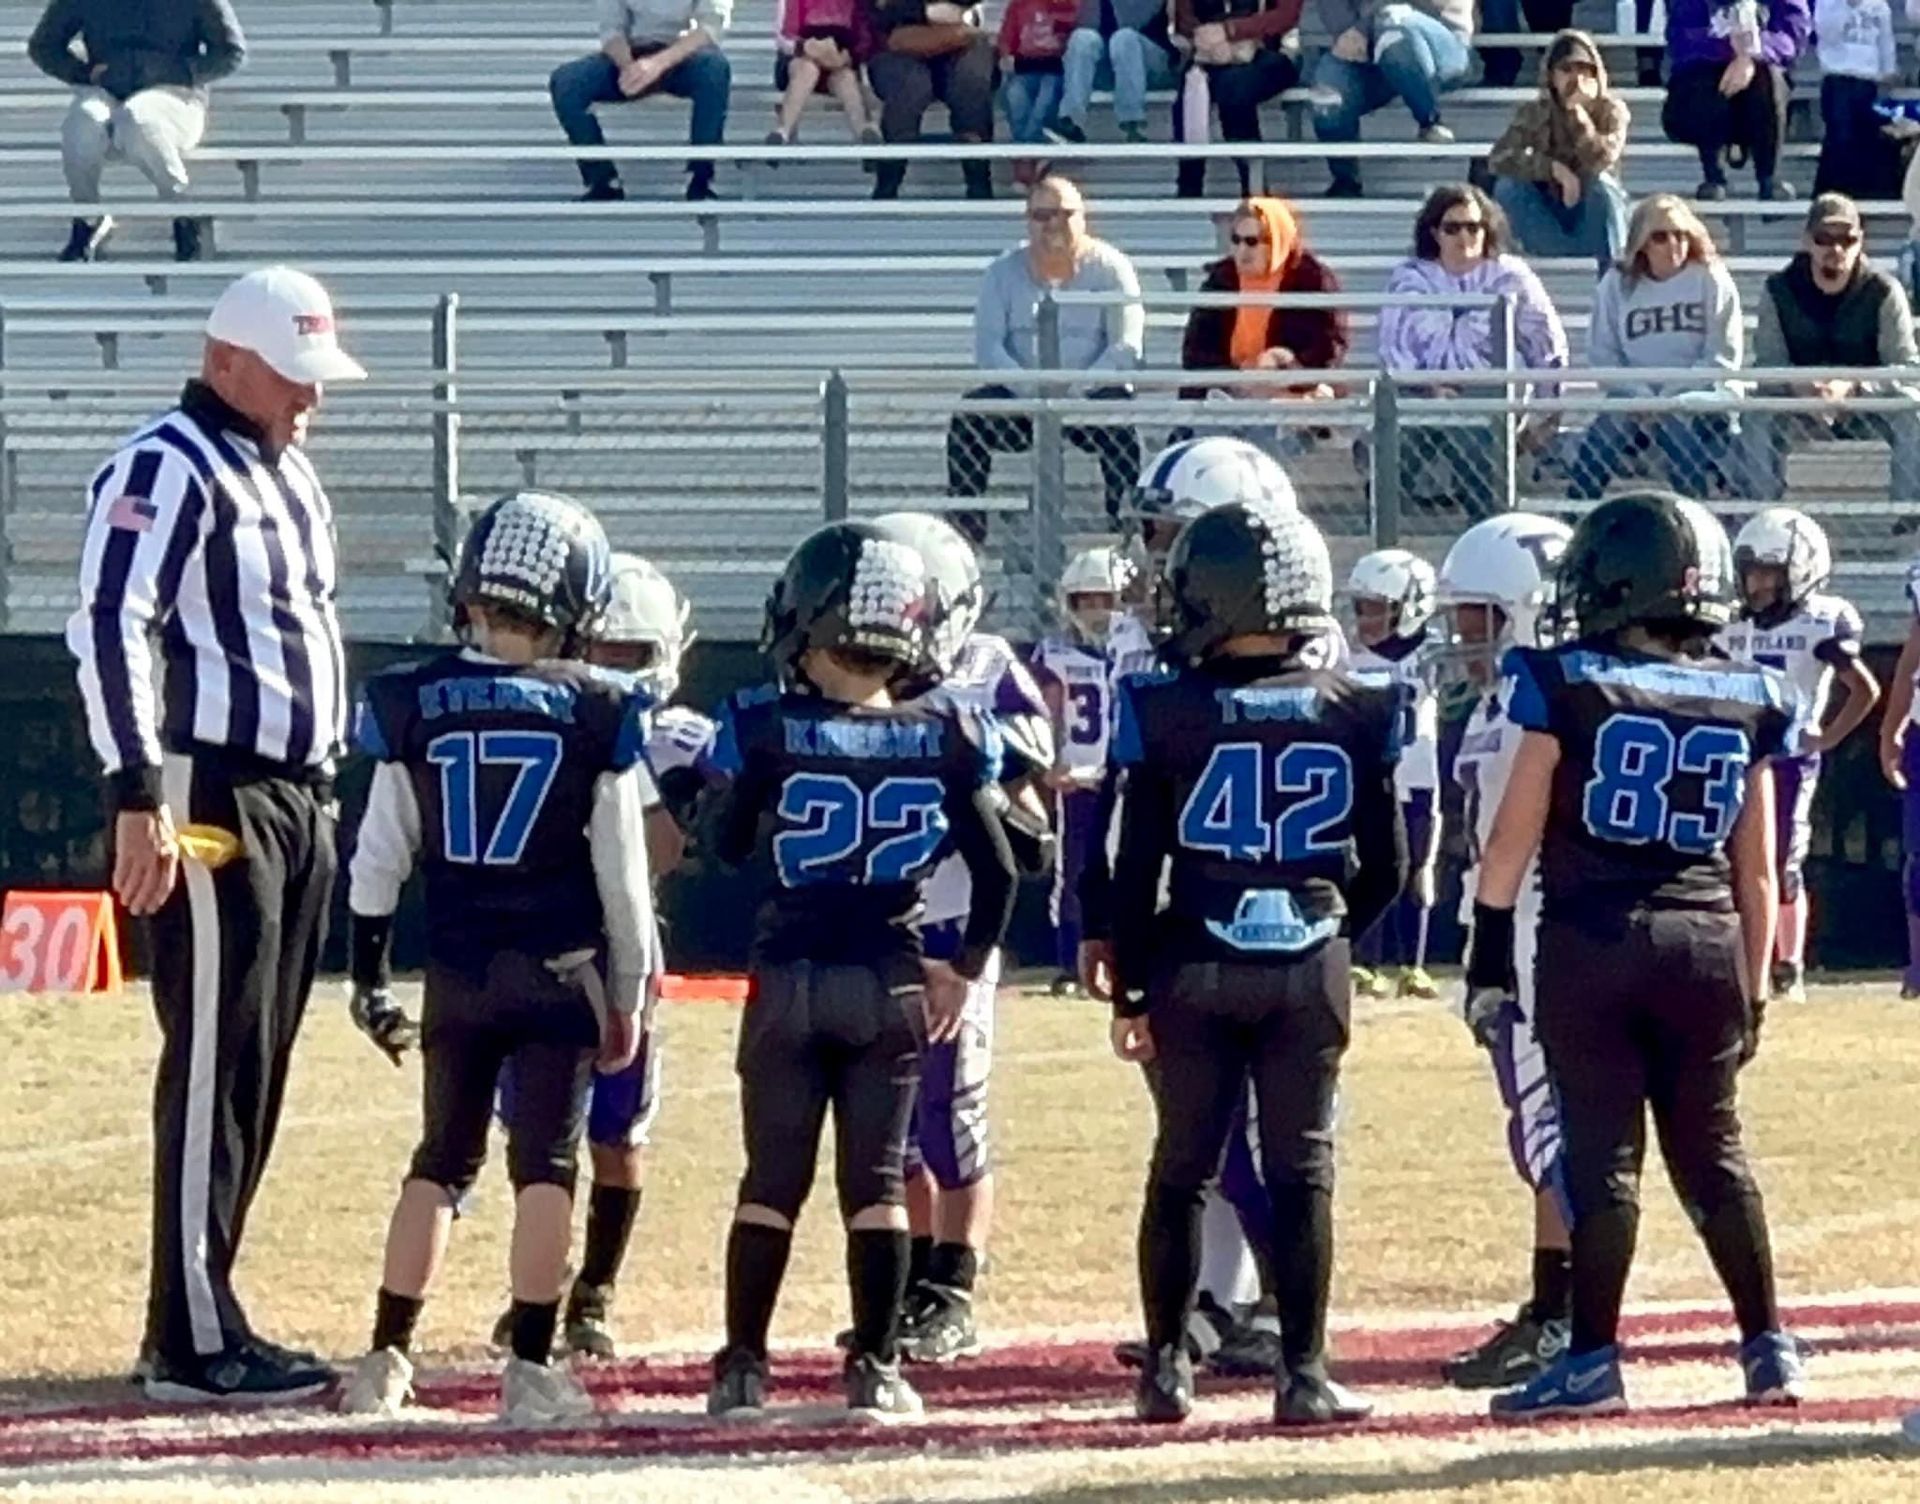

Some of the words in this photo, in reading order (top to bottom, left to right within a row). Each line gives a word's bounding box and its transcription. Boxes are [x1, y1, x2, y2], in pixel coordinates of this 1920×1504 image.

[1626, 302, 1706, 339] GHS
[1068, 683, 1102, 745] 3
[426, 731, 563, 865] 17
[773, 772, 949, 888] 22
[1178, 740, 1354, 863] 42
[1582, 712, 1749, 855] 83
[0, 905, 90, 989] 30
